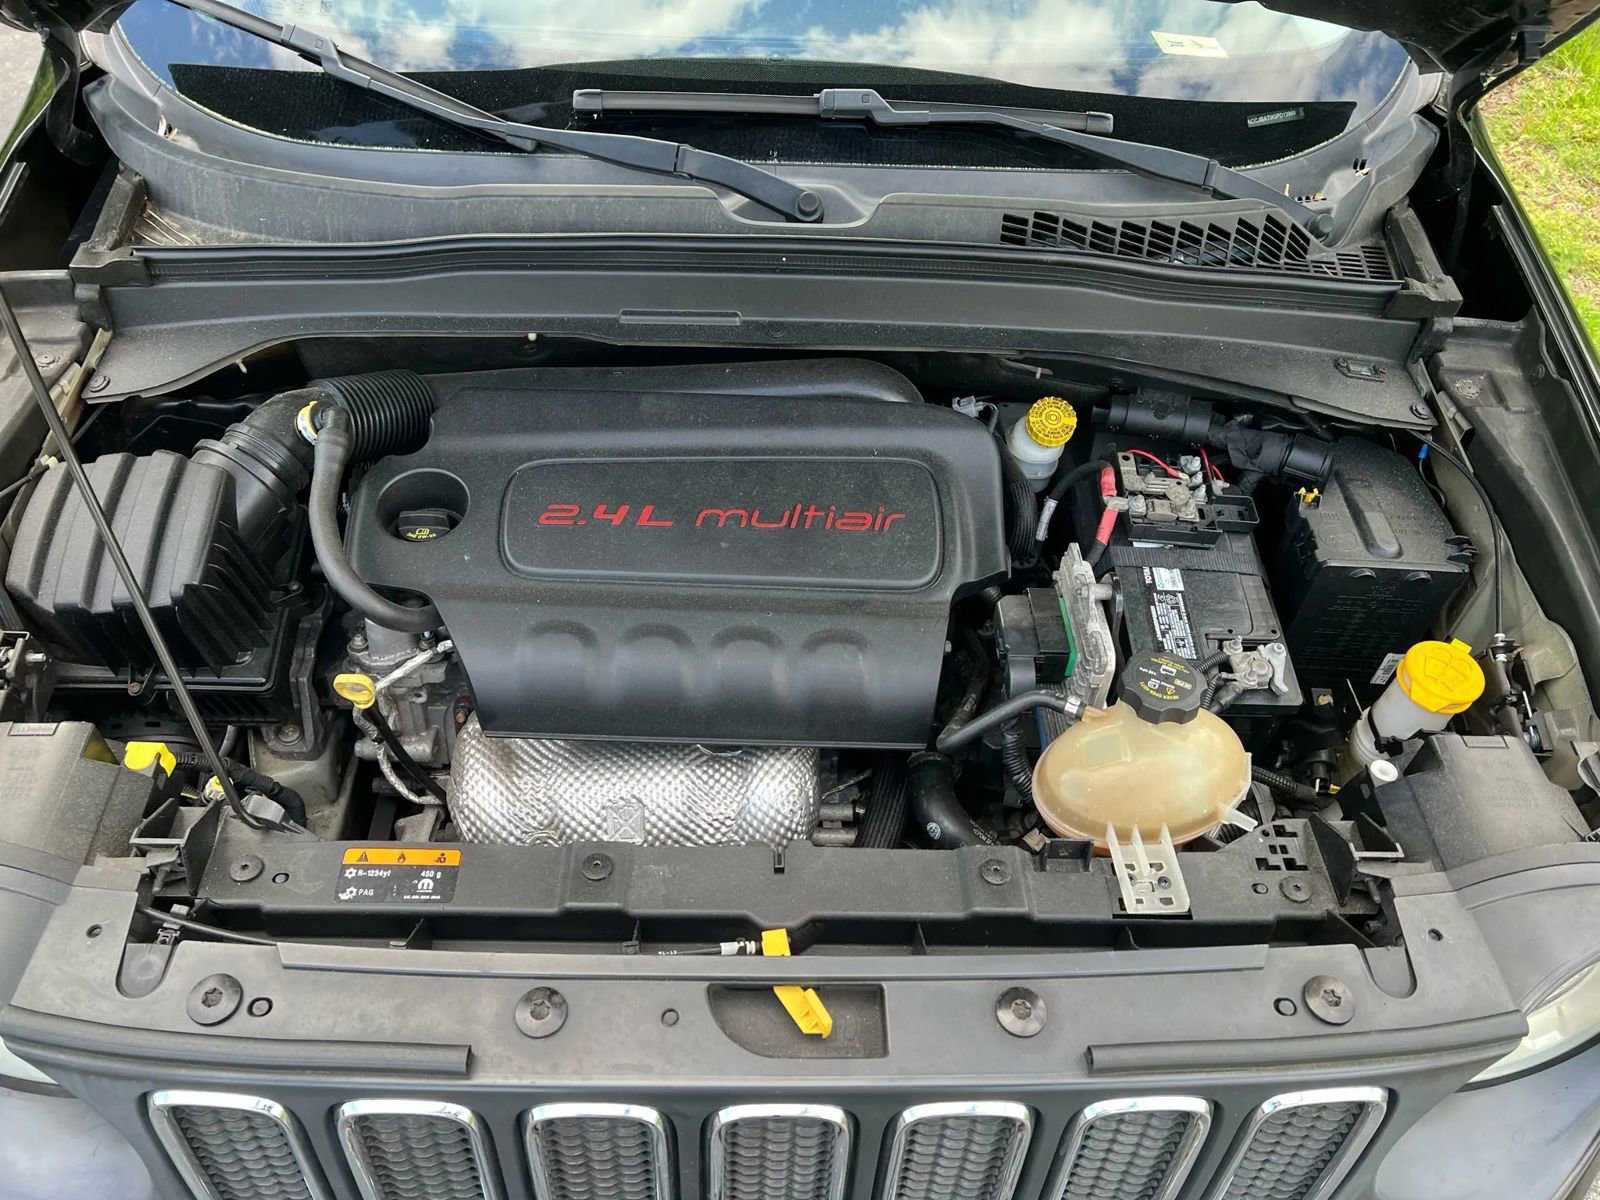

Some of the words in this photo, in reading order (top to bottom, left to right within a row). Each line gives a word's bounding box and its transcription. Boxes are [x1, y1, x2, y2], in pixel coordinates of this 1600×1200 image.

[538, 503, 674, 527] 2.4L
[695, 503, 906, 531] multiair
[357, 869, 392, 879] R-1234yf
[420, 870, 435, 878] 450
[358, 888, 374, 896] PAG
